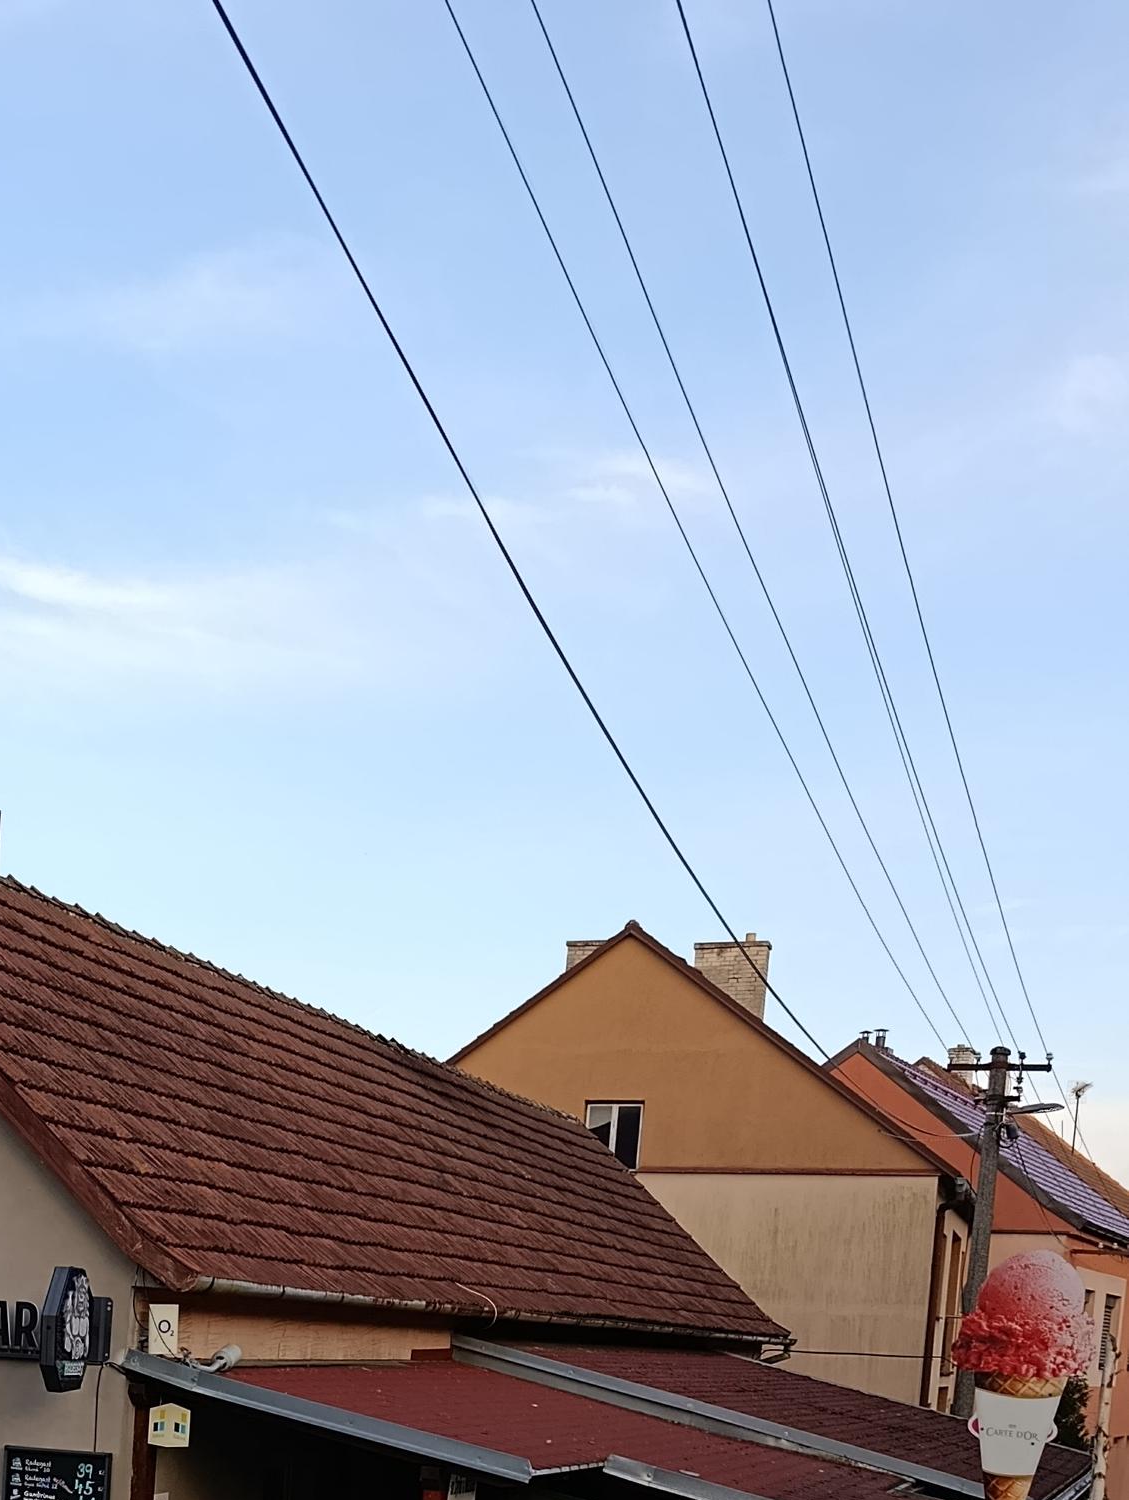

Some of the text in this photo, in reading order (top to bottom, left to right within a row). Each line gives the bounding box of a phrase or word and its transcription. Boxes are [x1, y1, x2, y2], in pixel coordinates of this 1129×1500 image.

[986, 1426, 1013, 1438] CARTE
[76, 1463, 93, 1479] 39
[74, 1479, 95, 1496] 45
[23, 1490, 56, 1500] Gambrinus
